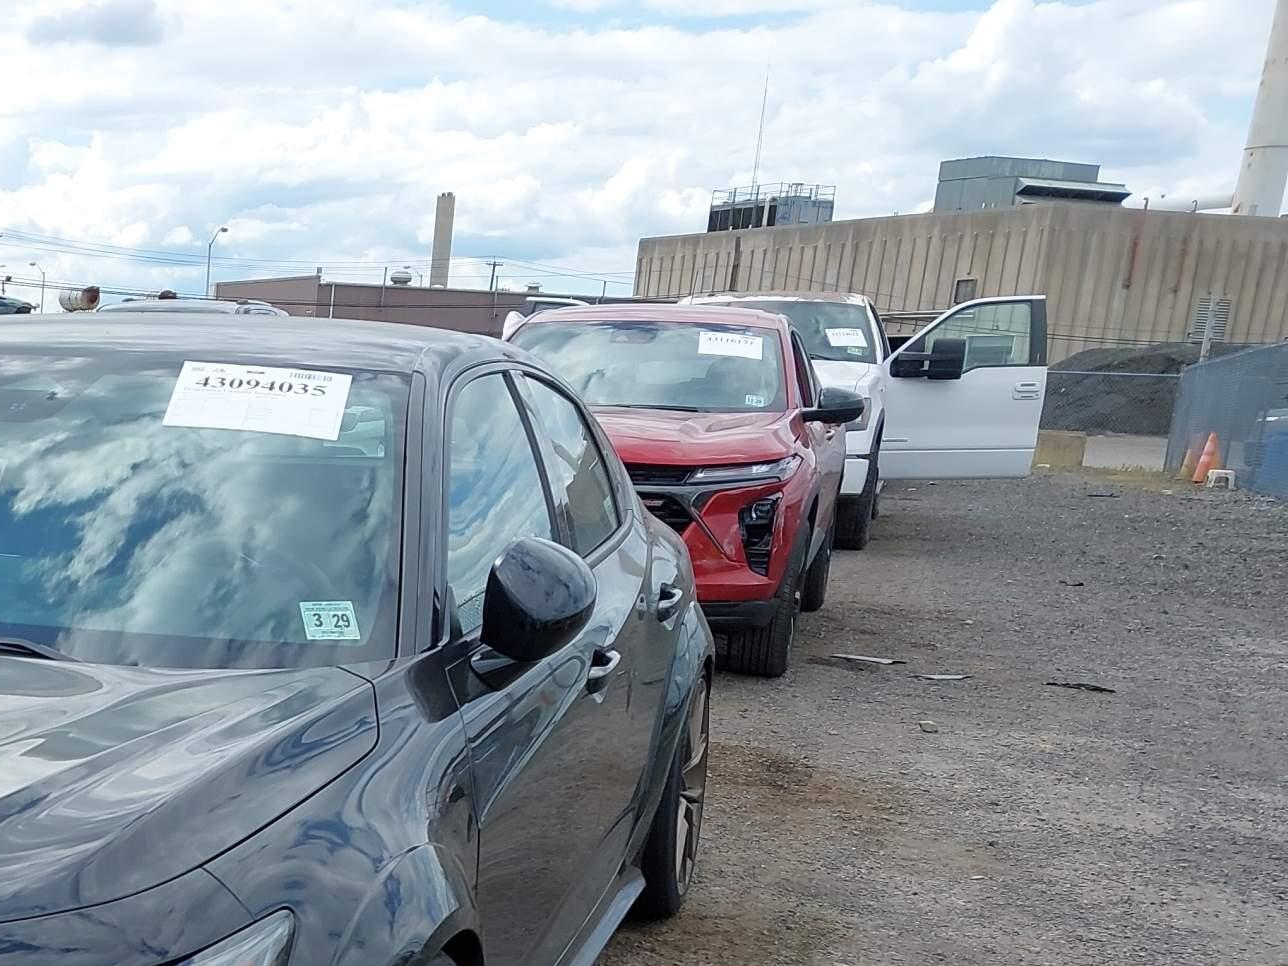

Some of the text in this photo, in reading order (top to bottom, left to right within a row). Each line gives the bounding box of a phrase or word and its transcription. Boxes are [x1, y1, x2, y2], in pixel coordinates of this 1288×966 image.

[195, 375, 328, 397] 43094035
[312, 613, 351, 628] 3 29
